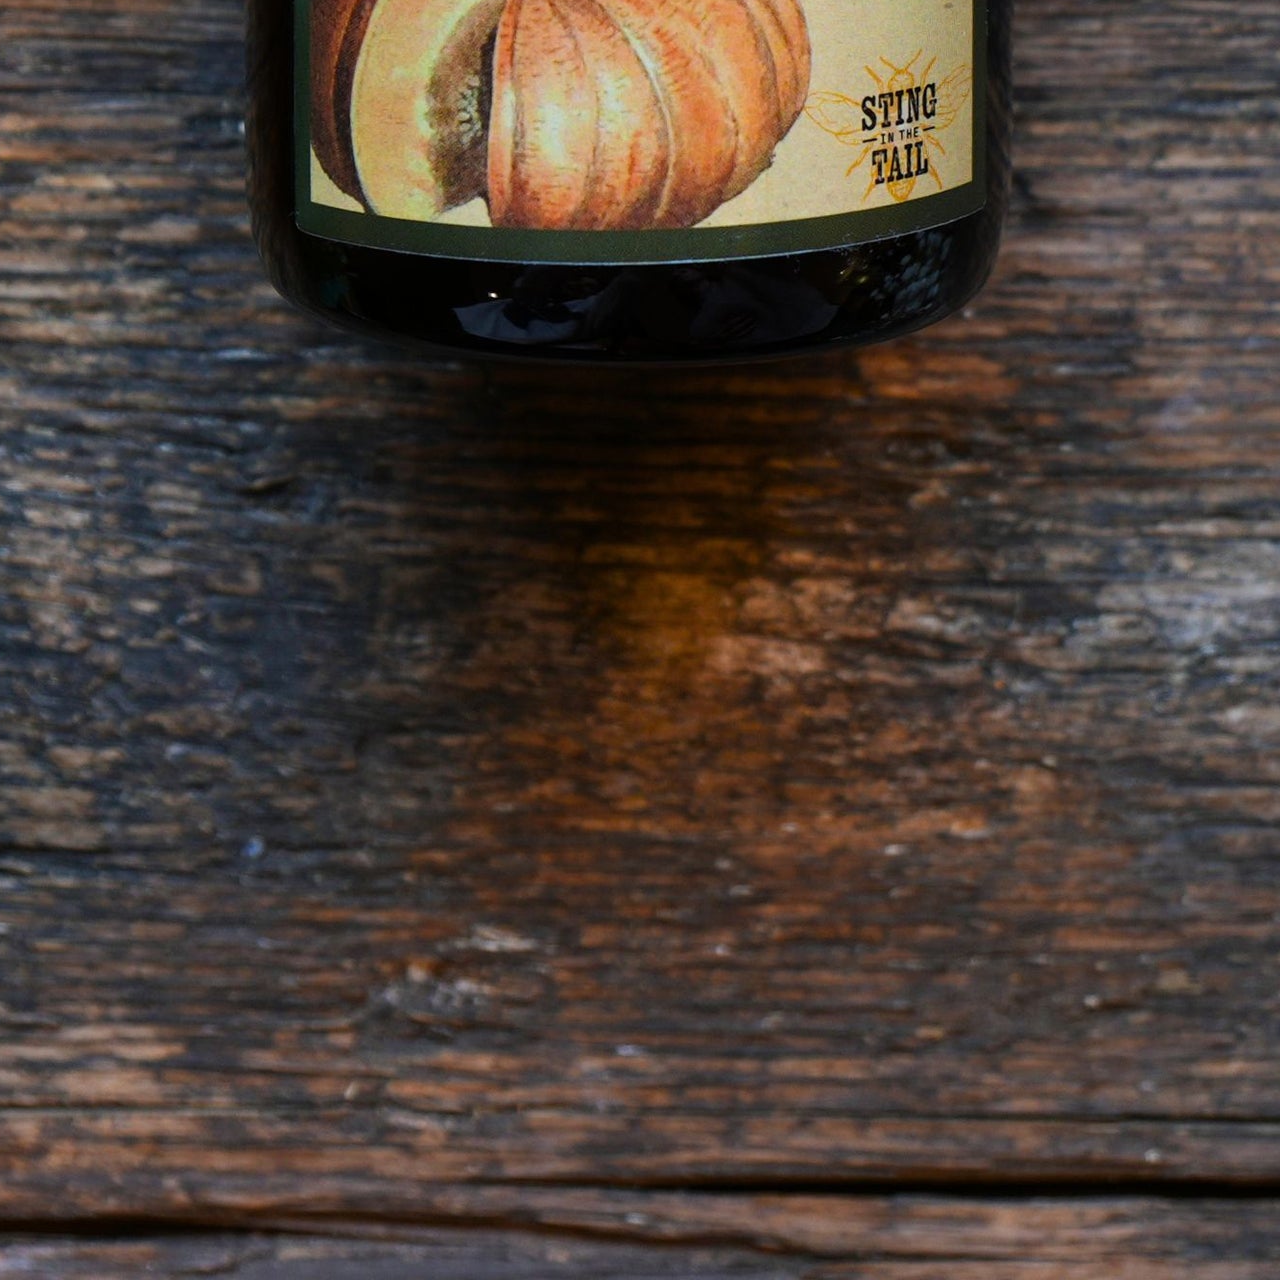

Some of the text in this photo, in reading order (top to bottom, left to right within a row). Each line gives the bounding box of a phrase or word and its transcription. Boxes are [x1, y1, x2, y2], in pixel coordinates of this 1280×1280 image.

[861, 83, 937, 131] STING
[881, 126, 919, 145] IN THE
[872, 141, 928, 185] TAIL
